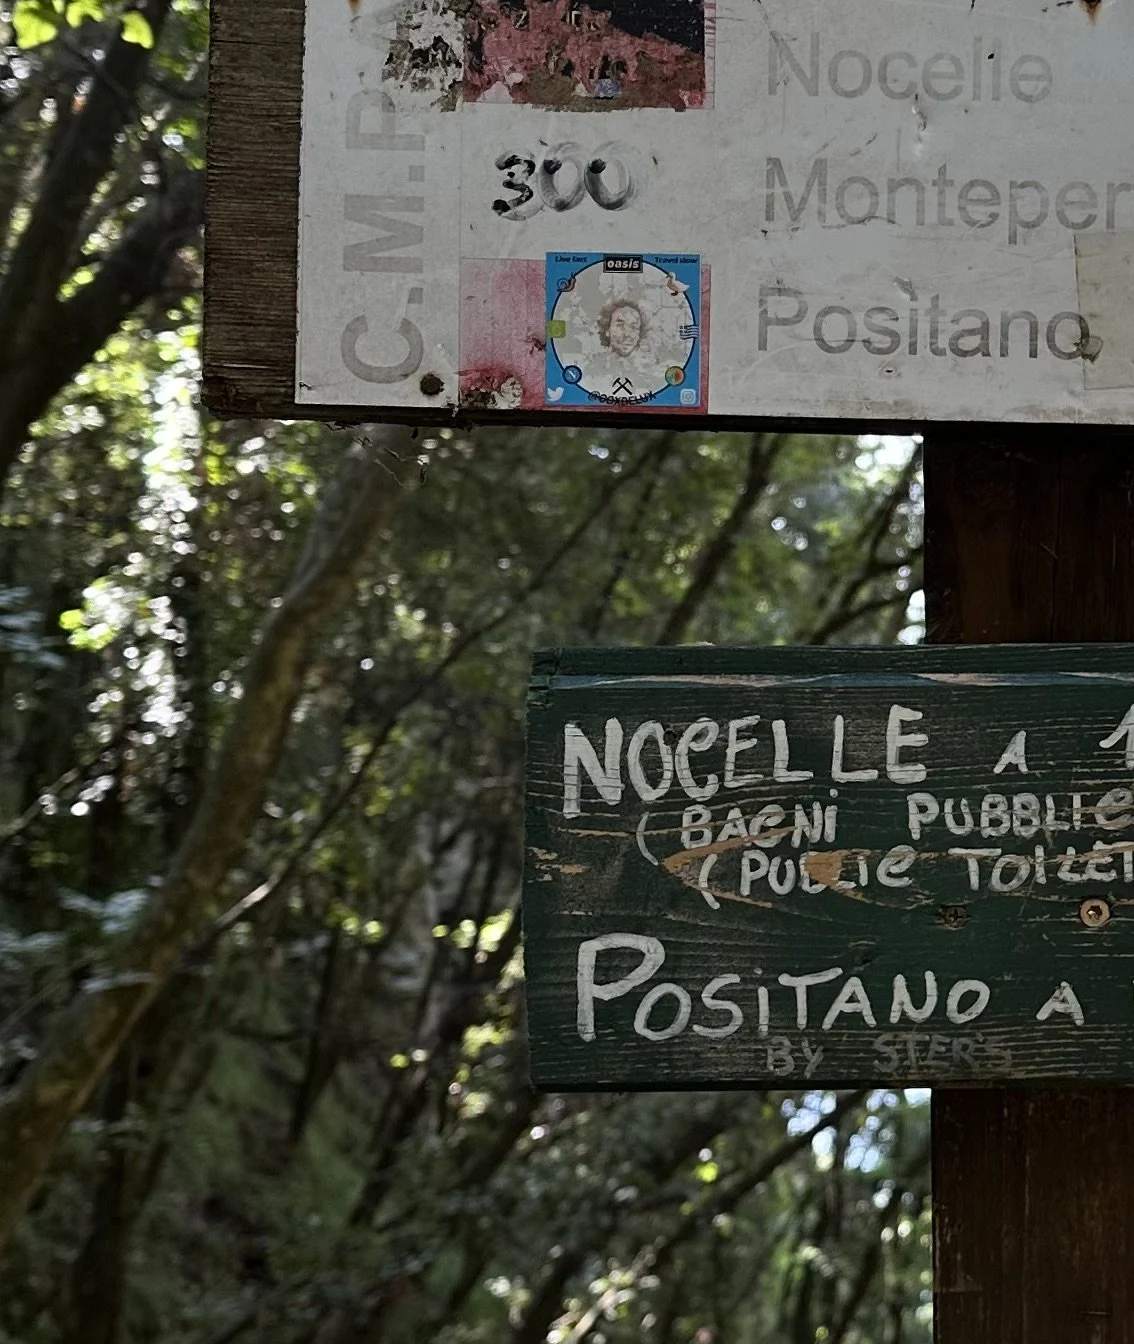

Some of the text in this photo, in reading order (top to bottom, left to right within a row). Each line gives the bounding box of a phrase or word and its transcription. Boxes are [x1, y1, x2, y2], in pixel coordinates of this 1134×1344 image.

[767, 31, 1053, 104] Nocelle
[492, 141, 637, 221] 300
[607, 258, 640, 269] oasis
[757, 284, 1091, 360] Positano
[563, 704, 928, 820] NOCELLE
[994, 730, 1029, 775] A
[1035, 980, 1085, 1026] A
[767, 1035, 824, 1079] BY
